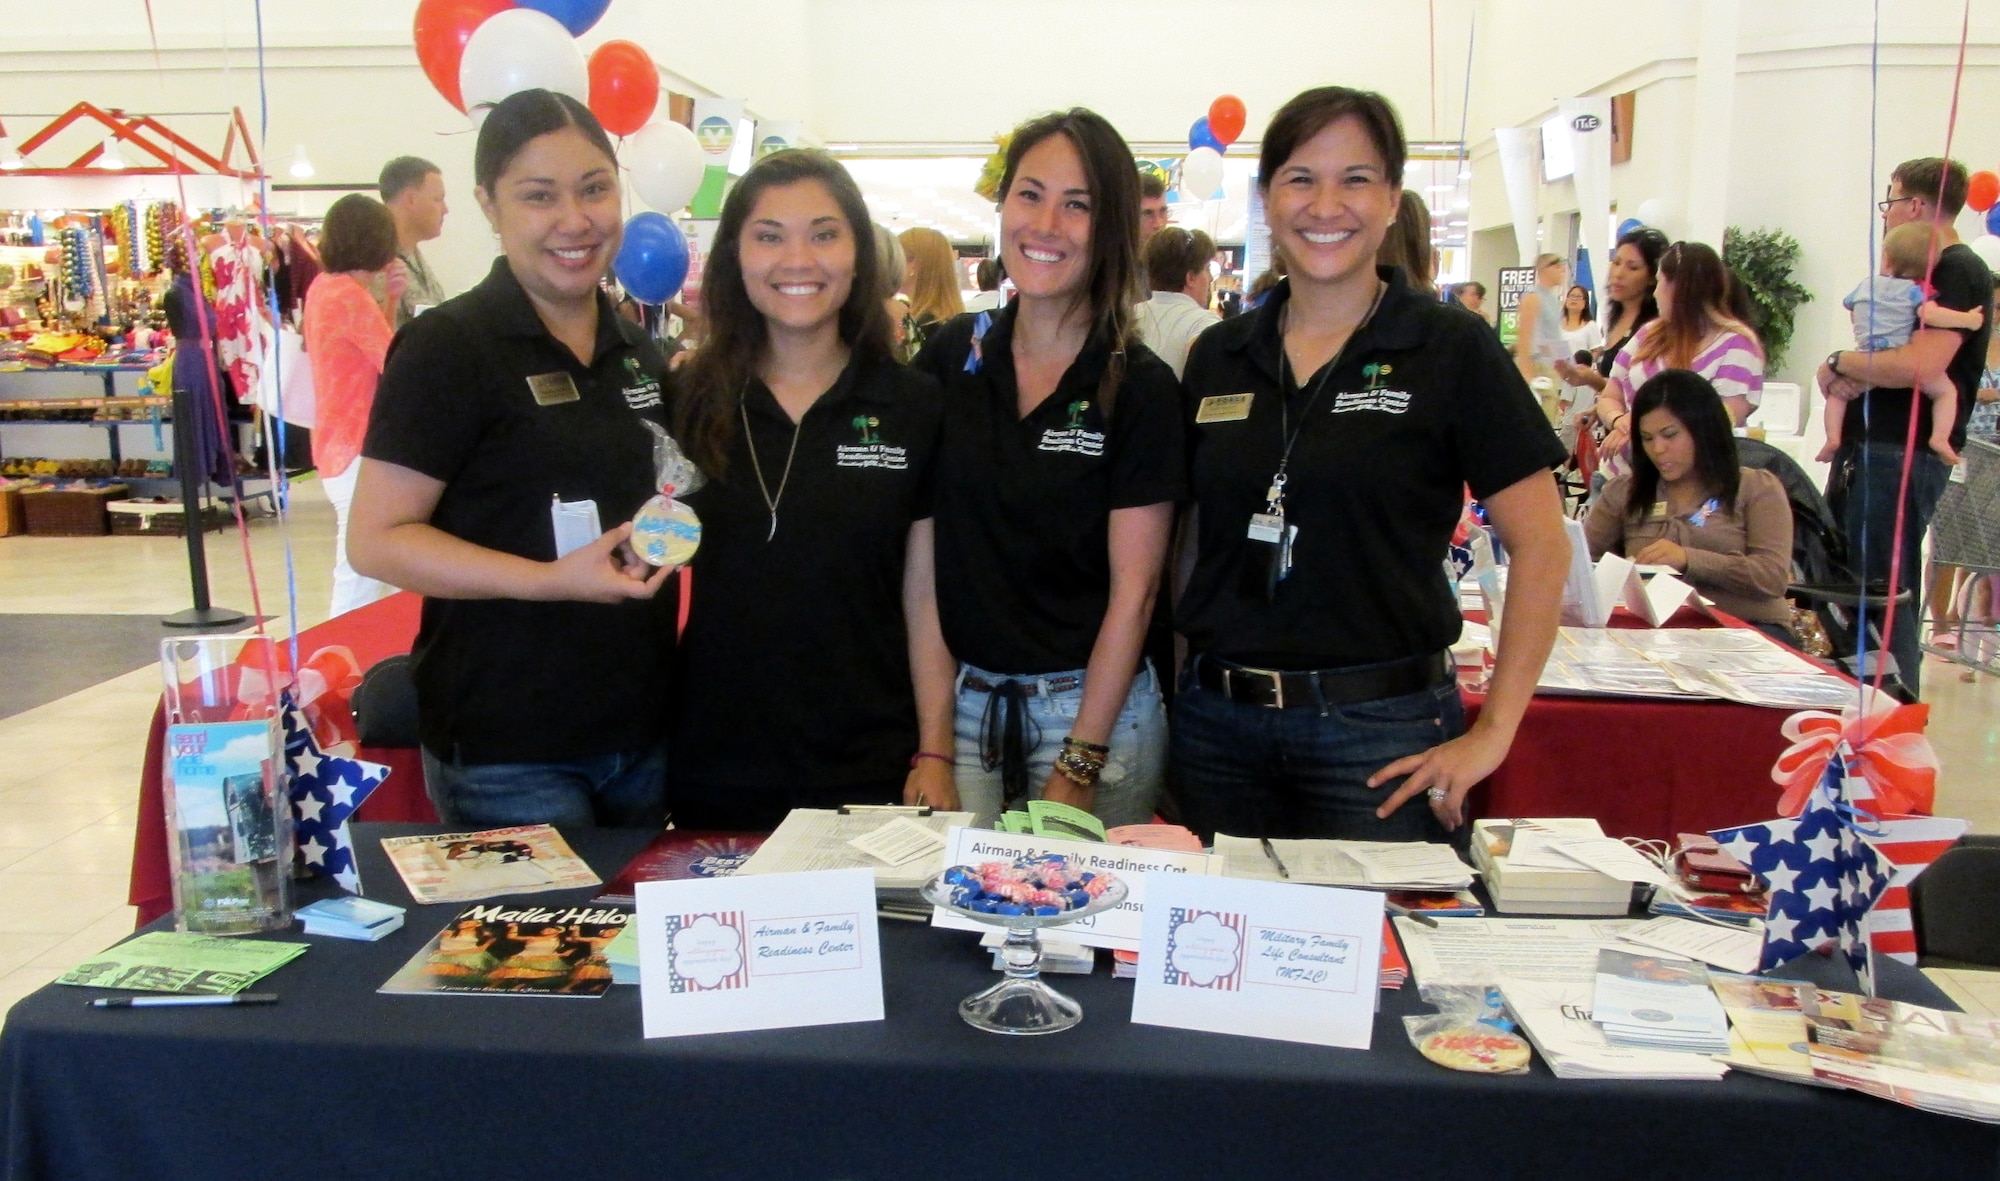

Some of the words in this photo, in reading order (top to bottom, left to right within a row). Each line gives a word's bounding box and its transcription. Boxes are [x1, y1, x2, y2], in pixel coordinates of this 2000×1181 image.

[1574, 117, 1598, 129] IT&E
[1501, 269, 1535, 285] FREE
[1379, 388, 1413, 401] Family
[1377, 397, 1410, 408] Center
[1076, 428, 1106, 442] Family
[879, 444, 906, 456] Family
[1075, 437, 1104, 449] Center
[880, 453, 906, 462] Center
[175, 730, 208, 745] send
[387, 833, 472, 847] MILITARY
[971, 842, 1022, 858] Airman
[753, 924, 797, 938] Airman
[802, 921, 811, 934] &
[814, 920, 855, 934] Family
[1260, 930, 1308, 949] Military
[1310, 935, 1350, 951] Family
[758, 945, 814, 958] Readiness
[818, 941, 854, 956] Center
[1261, 946, 1285, 961] Life
[1288, 948, 1347, 964] Consultant
[1276, 966, 1328, 984] (MFLC)
